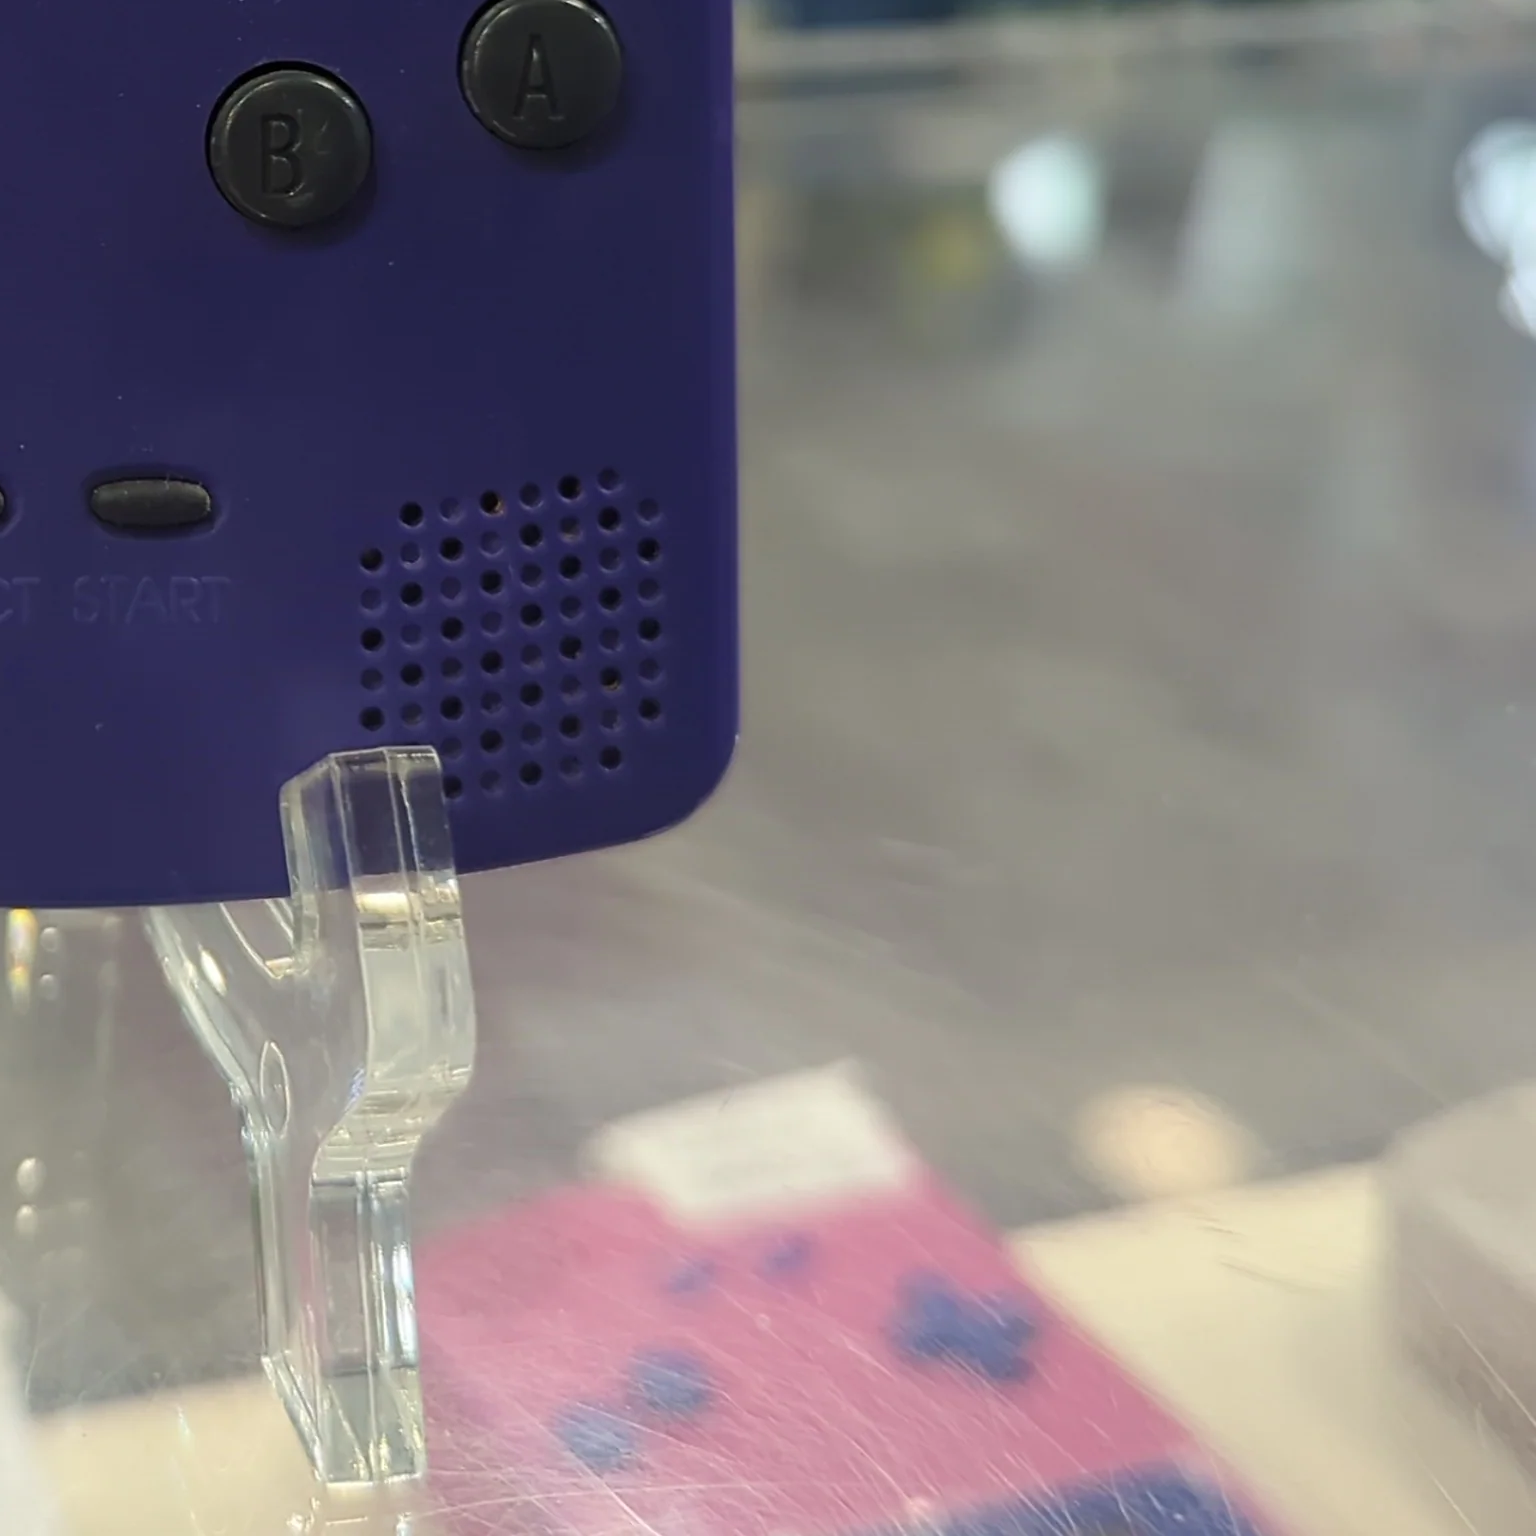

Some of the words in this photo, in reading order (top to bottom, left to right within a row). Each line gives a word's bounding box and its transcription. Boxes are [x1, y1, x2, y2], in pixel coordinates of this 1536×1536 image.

[513, 33, 565, 120] A
[260, 112, 304, 196] B
[72, 575, 232, 624] START
